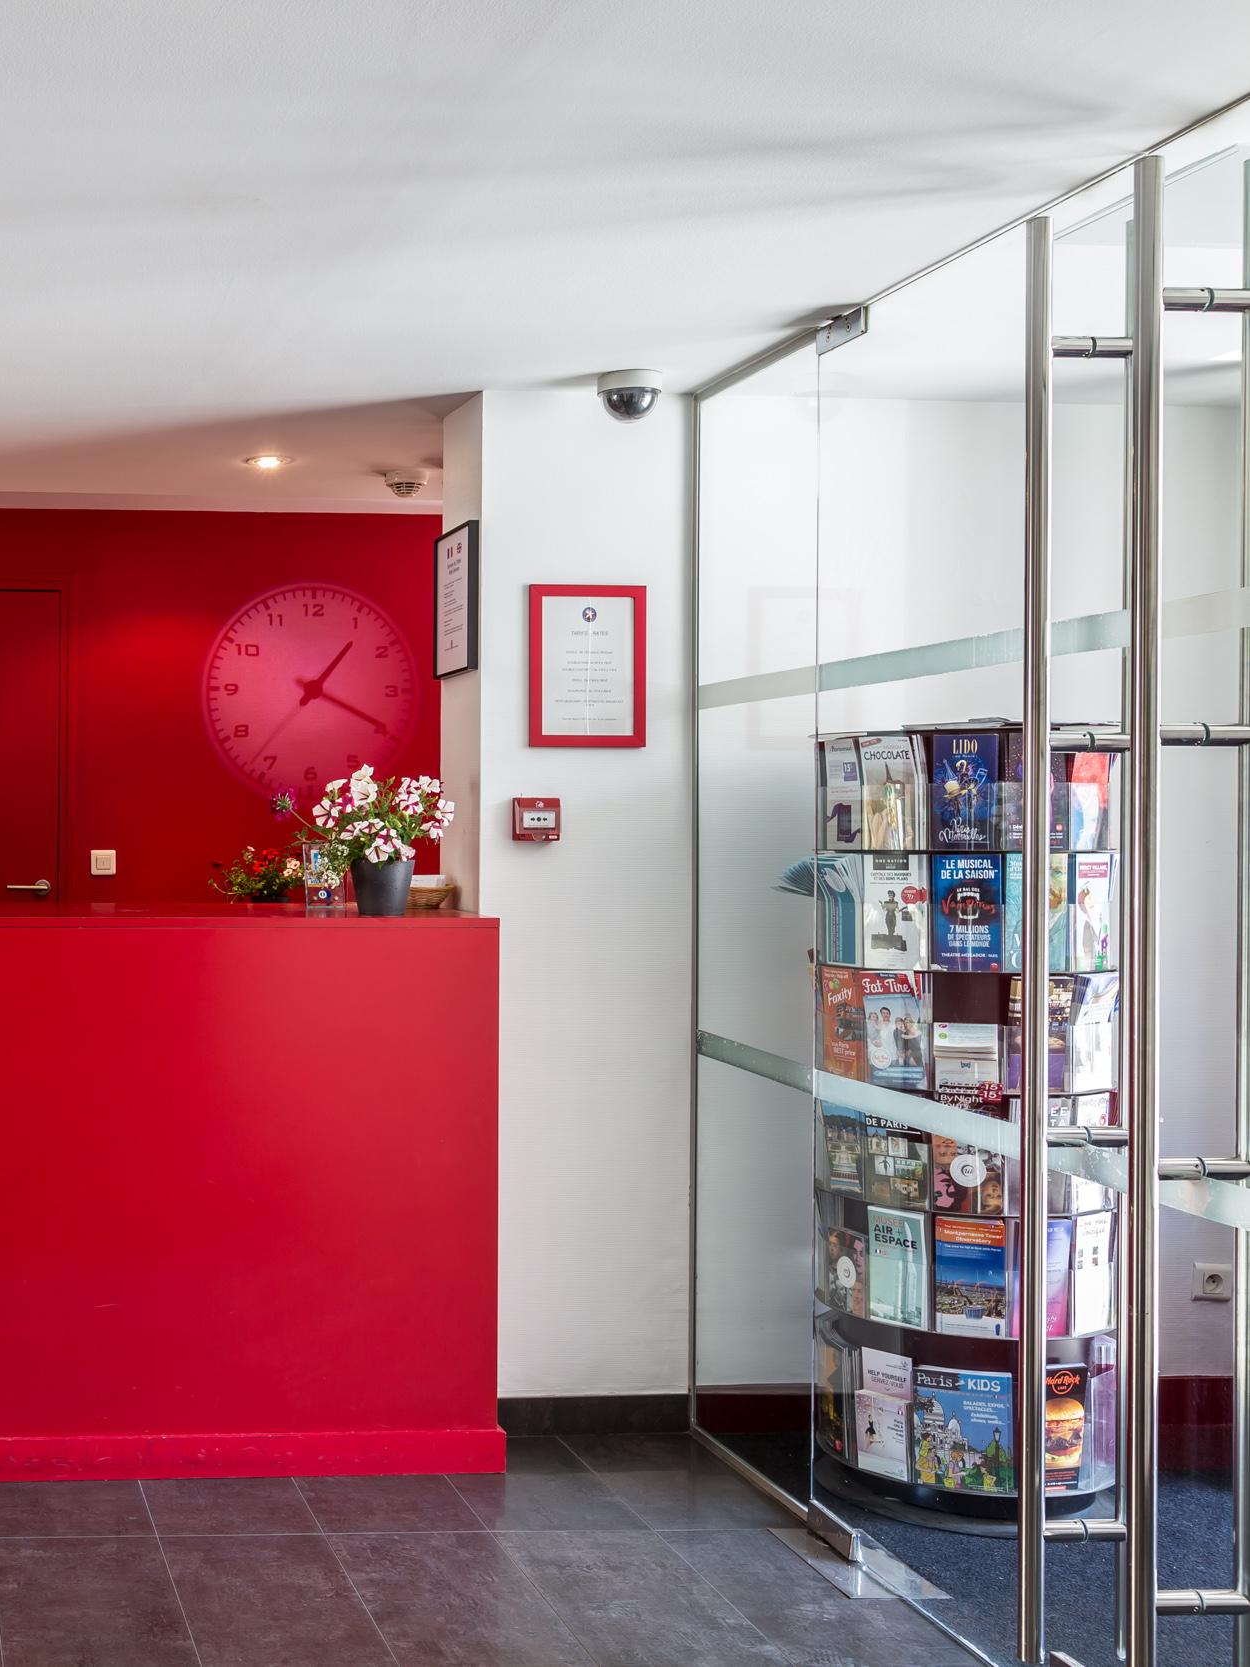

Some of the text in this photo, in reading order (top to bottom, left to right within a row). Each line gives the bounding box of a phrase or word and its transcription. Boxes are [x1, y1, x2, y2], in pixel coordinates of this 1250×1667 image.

[302, 604, 324, 616] 12
[267, 614, 283, 627] 11
[352, 617, 358, 629] 1
[235, 644, 259, 657] 10
[375, 646, 389, 658] 2
[224, 683, 239, 696] 9
[385, 685, 399, 697] 3
[233, 725, 249, 738] 8
[953, 739, 978, 755] LIDO
[346, 755, 361, 768] 5
[864, 750, 910, 760] CHOCOLATE
[263, 756, 277, 769] 7
[304, 767, 317, 781] 6
[957, 859, 993, 869] MUSICAL
[941, 870, 952, 879] DE
[953, 870, 964, 879] LA
[950, 925, 989, 933] 7 MILLIONS
[862, 978, 910, 993] Fat Tire
[828, 987, 852, 1006] Foxity
[940, 1094, 983, 1103] By Night
[866, 1117, 908, 1129] DE PARIS
[874, 1224, 893, 1234] AIR
[874, 1234, 917, 1250] ESPACE
[956, 1236, 991, 1244] Observatory
[868, 1369, 907, 1384] HELP YOURSELF
[871, 1376, 904, 1389] SERVEZ-VOUS
[917, 1372, 1001, 1392] Paris KIDS
[1046, 1374, 1080, 1386] Hard Rock
